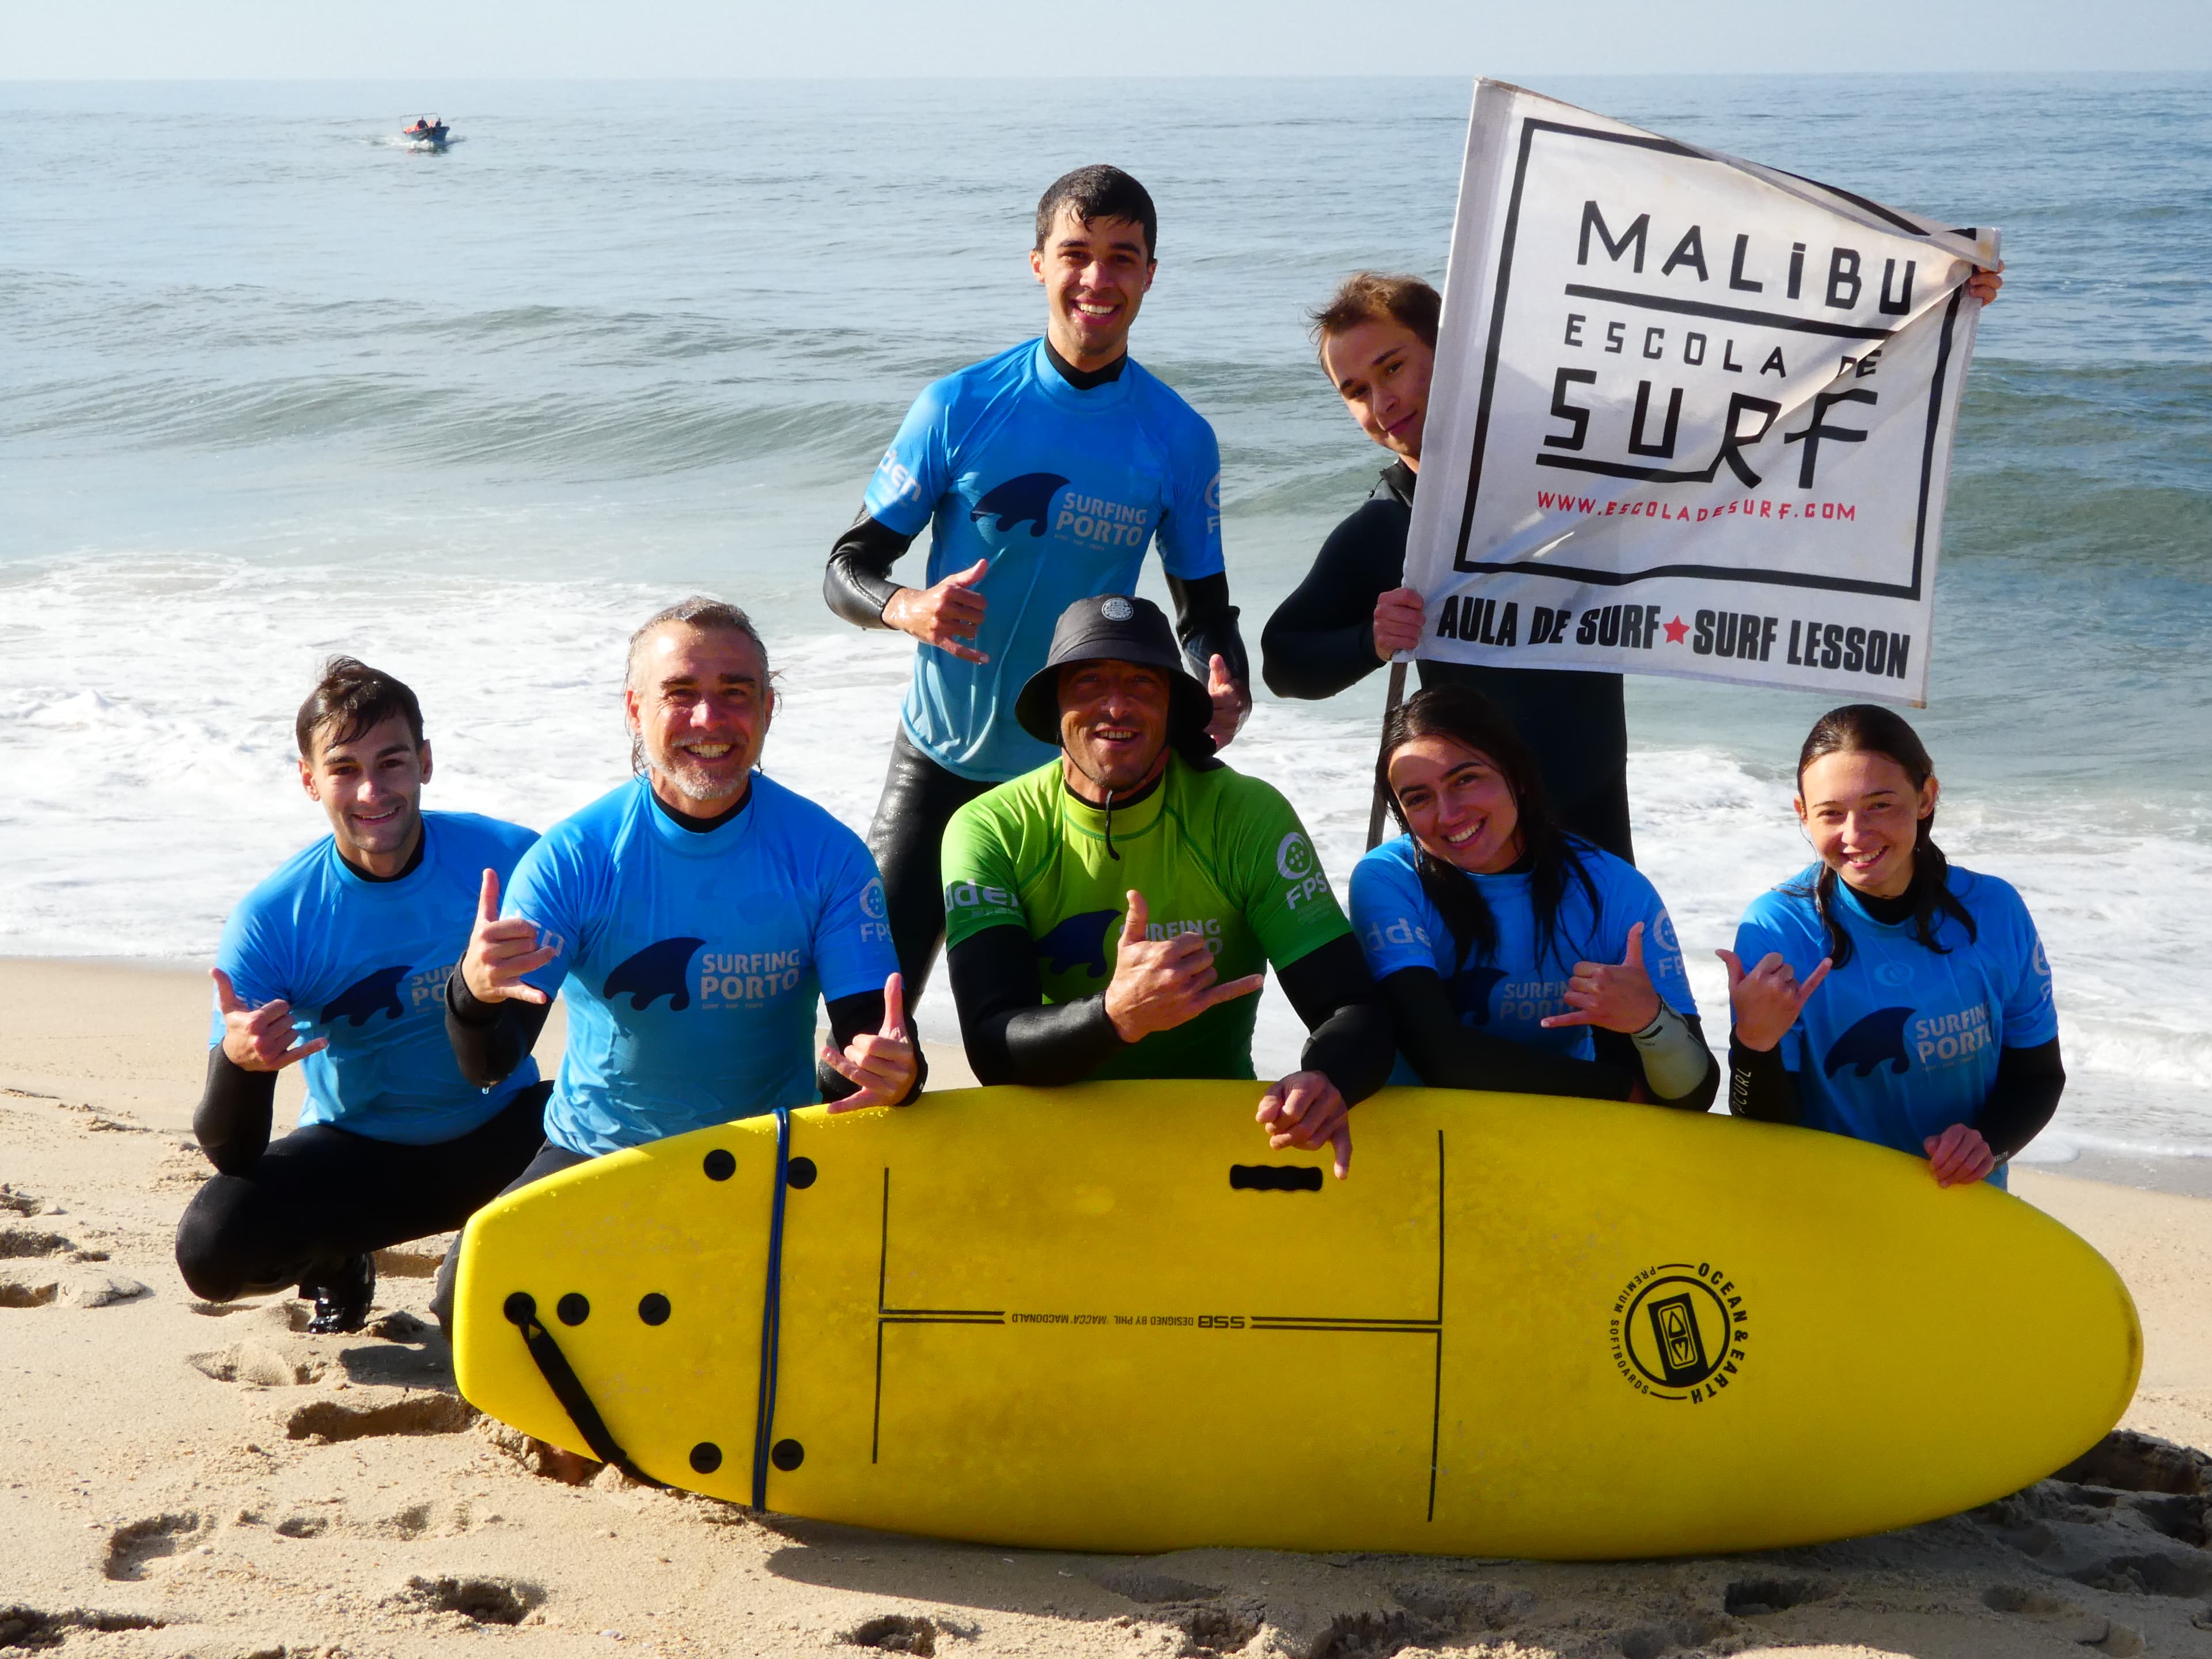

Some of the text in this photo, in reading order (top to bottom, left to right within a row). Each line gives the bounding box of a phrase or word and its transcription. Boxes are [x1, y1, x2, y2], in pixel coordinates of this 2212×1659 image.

[1564, 313, 1883, 378] ESCOLA DE
[1543, 367, 1878, 489] SURF
[1062, 492, 1148, 525] SURFING
[1537, 491, 1856, 522] WWW.ESCOLADESURF.COM
[1055, 510, 1143, 547] PORTO
[1436, 595, 1911, 679] AULA DE SURF SURF LESSON
[1286, 872, 1328, 910] FPS
[702, 949, 800, 974] SURFING
[700, 968, 800, 1000] PORTO
[1012, 1313, 1069, 1324] MACDONALD
[1113, 1315, 1133, 1324] PHIL
[1135, 1315, 1147, 1325] BY
[1150, 1316, 1194, 1326] DESIGNED
[1198, 1315, 1245, 1329] SSB
[1609, 1266, 1656, 1395] PREMIUM SOFTBOARDS
[1690, 1262, 1748, 1404] OCEAN & EARTH
